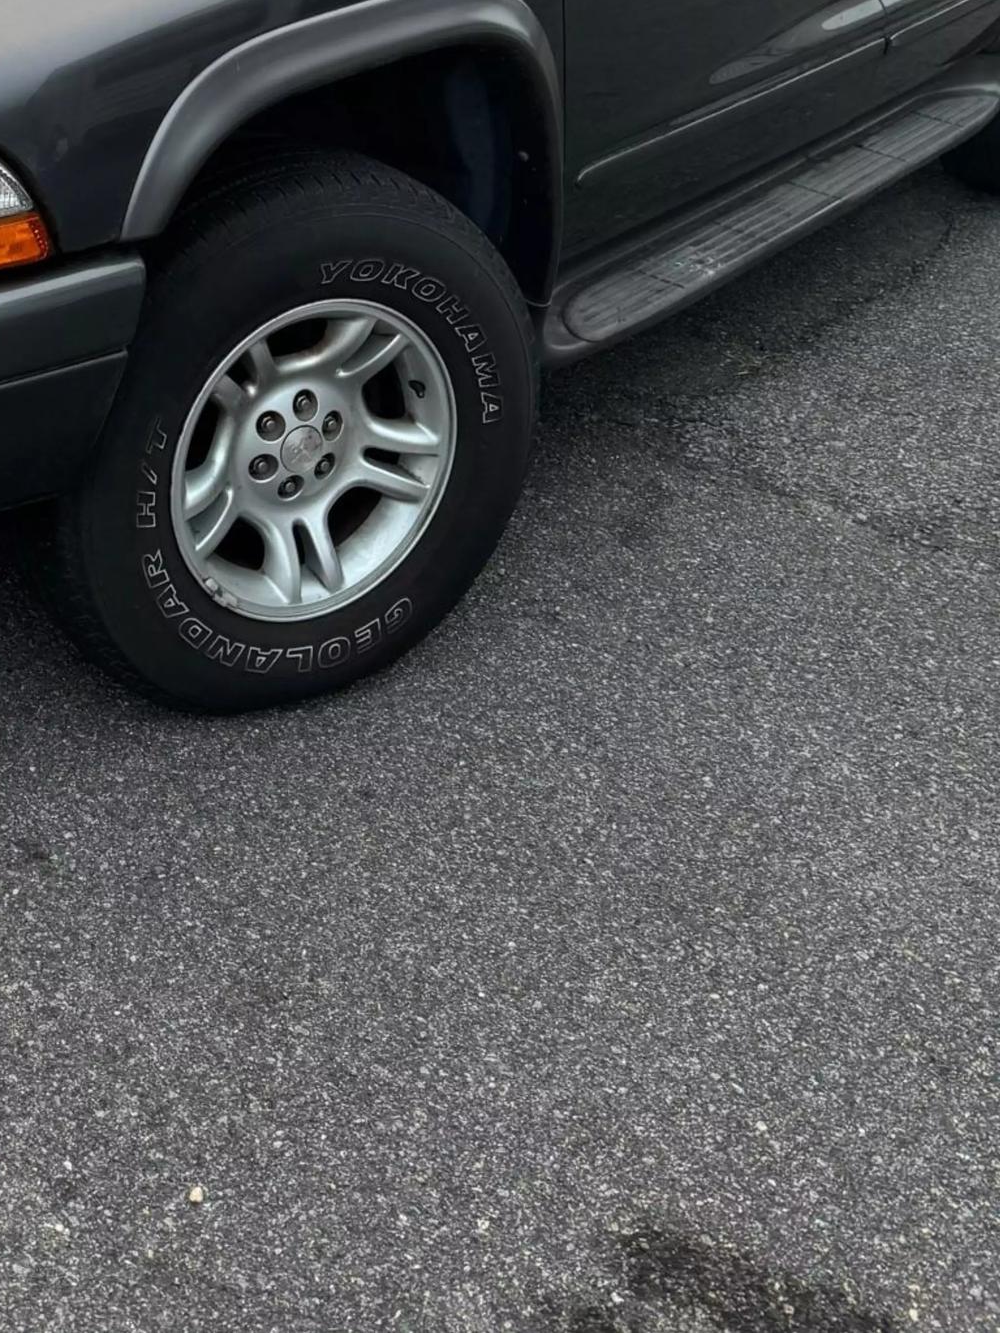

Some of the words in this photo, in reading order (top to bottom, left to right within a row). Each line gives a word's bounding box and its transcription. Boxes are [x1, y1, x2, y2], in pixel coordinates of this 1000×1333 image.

[319, 258, 504, 426] YOKOHAMA
[135, 416, 168, 530] H/T
[140, 548, 414, 674] GEOLANDAR
